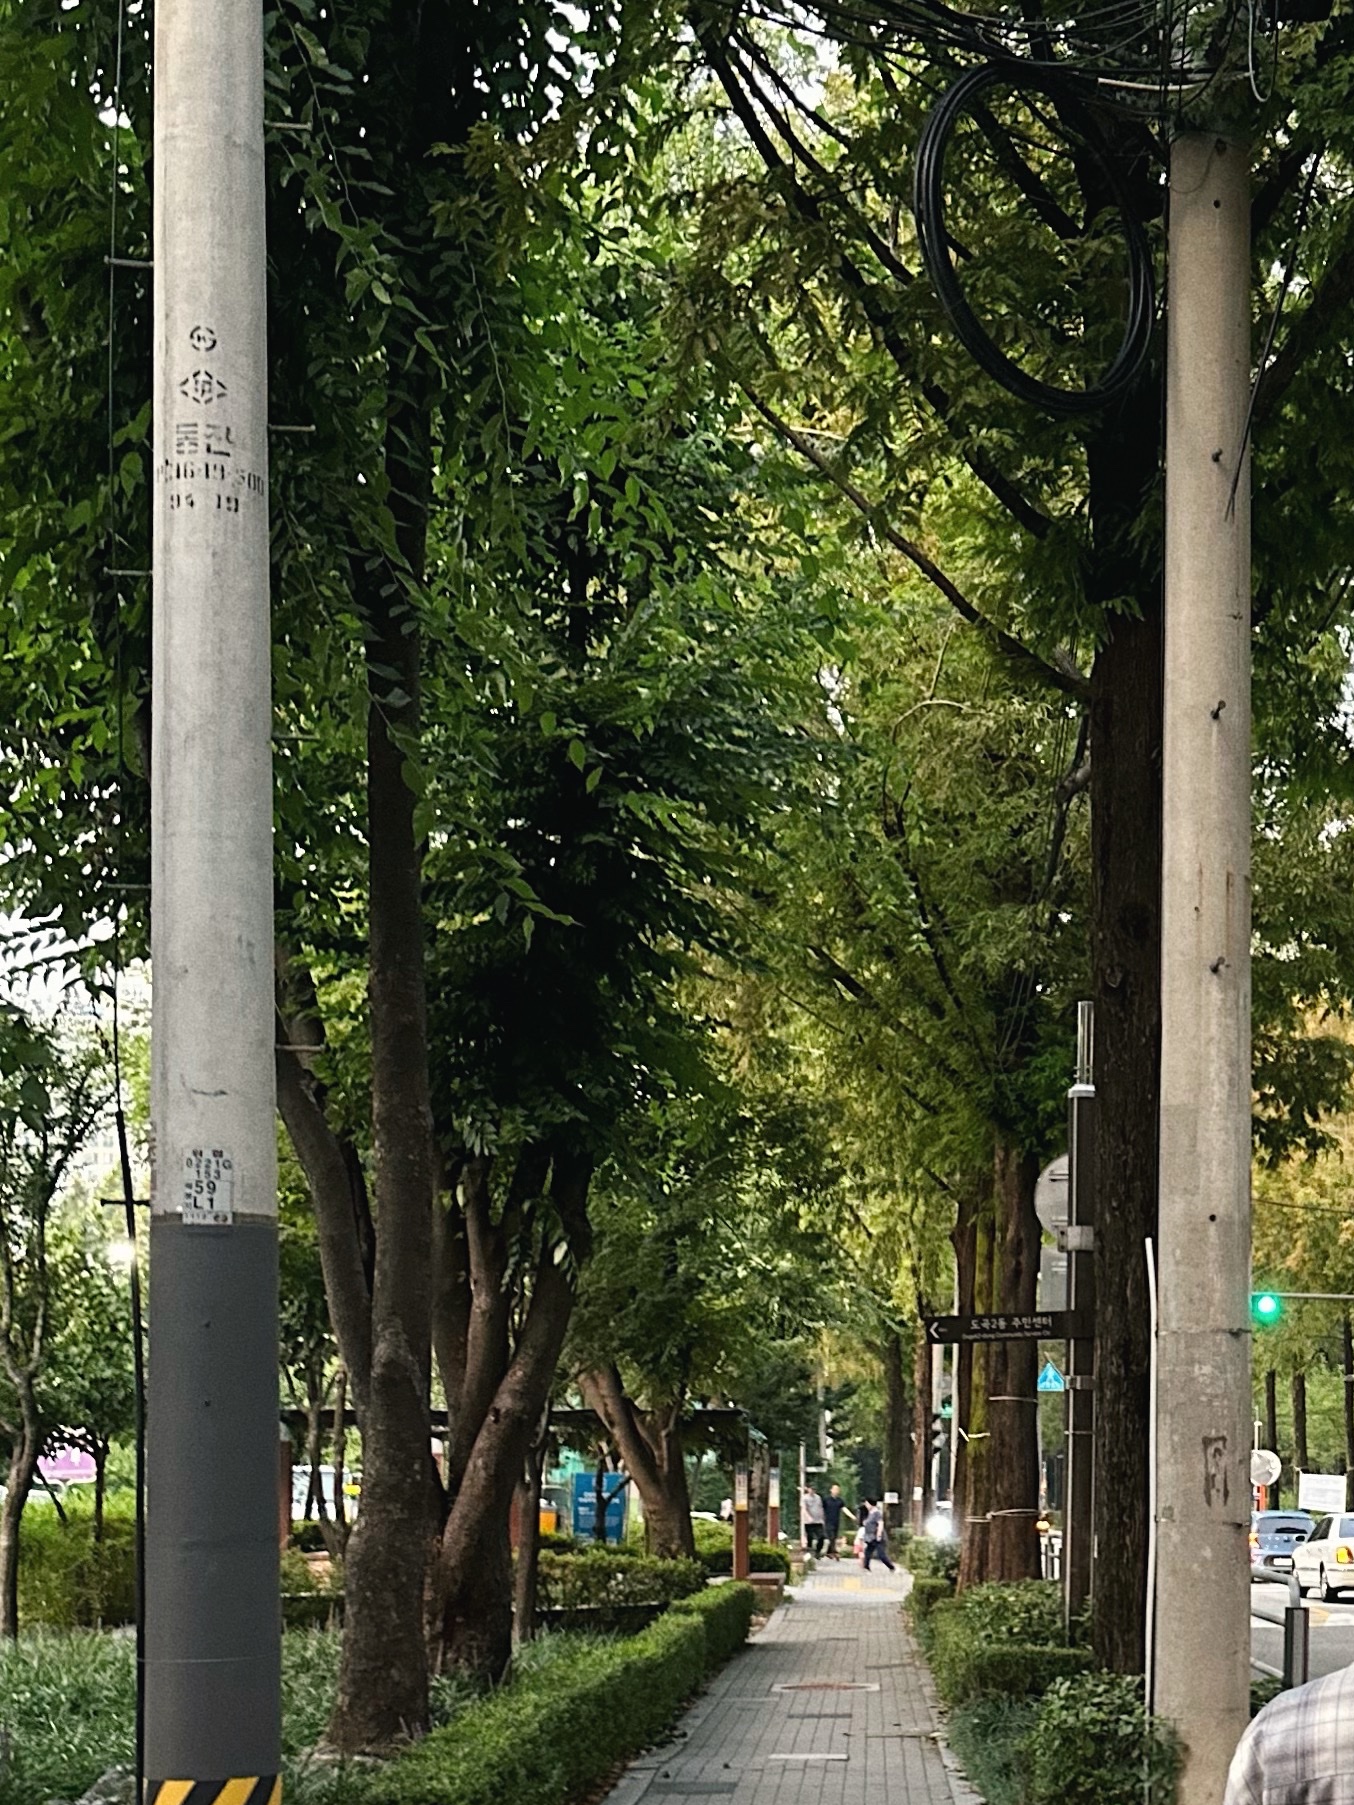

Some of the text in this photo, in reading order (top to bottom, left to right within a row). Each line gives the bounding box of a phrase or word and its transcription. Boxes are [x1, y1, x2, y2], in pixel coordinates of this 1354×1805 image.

[194, 1180, 216, 1195] 59
[193, 1196, 214, 1210] L1
[1011, 1315, 1052, 1329] 주민센터
